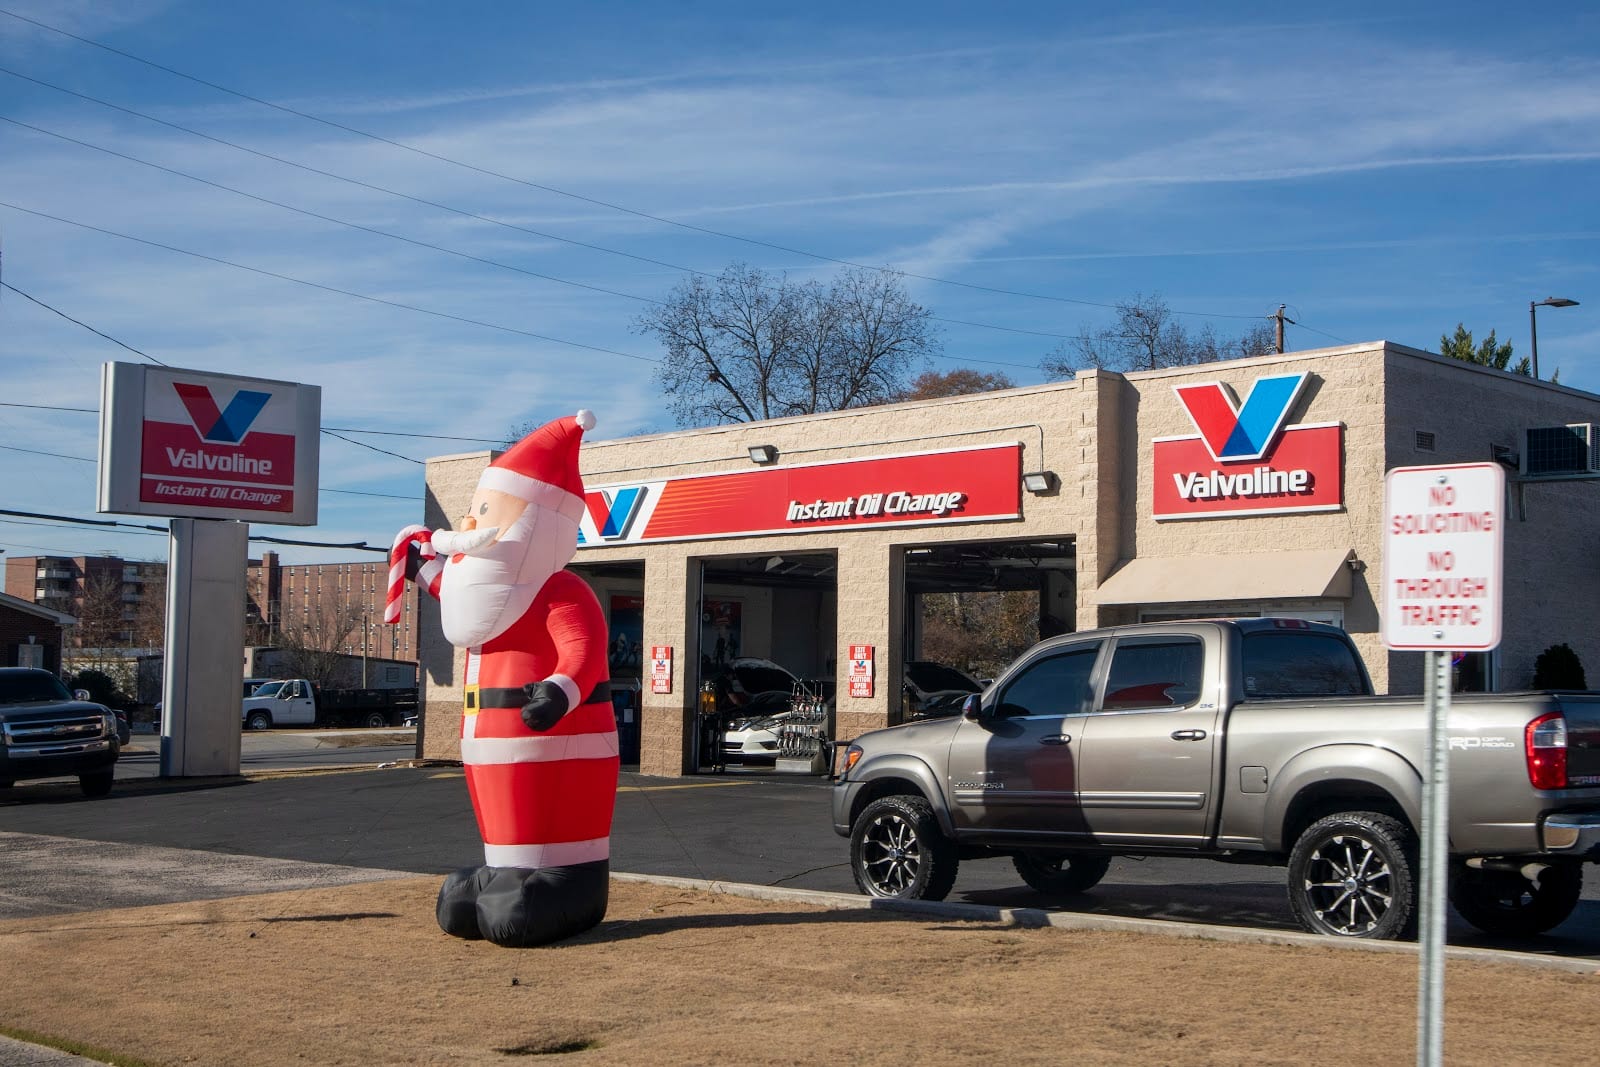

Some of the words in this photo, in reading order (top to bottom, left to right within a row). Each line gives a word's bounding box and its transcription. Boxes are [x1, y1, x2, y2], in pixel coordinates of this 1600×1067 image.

[165, 447, 273, 476] Valvoline
[155, 482, 209, 498] Instant
[209, 487, 227, 499] Oil
[230, 488, 282, 505] Change
[1172, 466, 1309, 499] Valvoline
[785, 496, 854, 522] Instant
[855, 492, 884, 516] Oil
[883, 490, 963, 516] Change
[1428, 486, 1457, 507] NO
[1391, 511, 1494, 535] SOLICITING
[1427, 550, 1457, 572] NO
[1394, 577, 1489, 600] THROUGH
[1400, 604, 1482, 627] TRAFFIC
[850, 675, 870, 683] CAUTION
